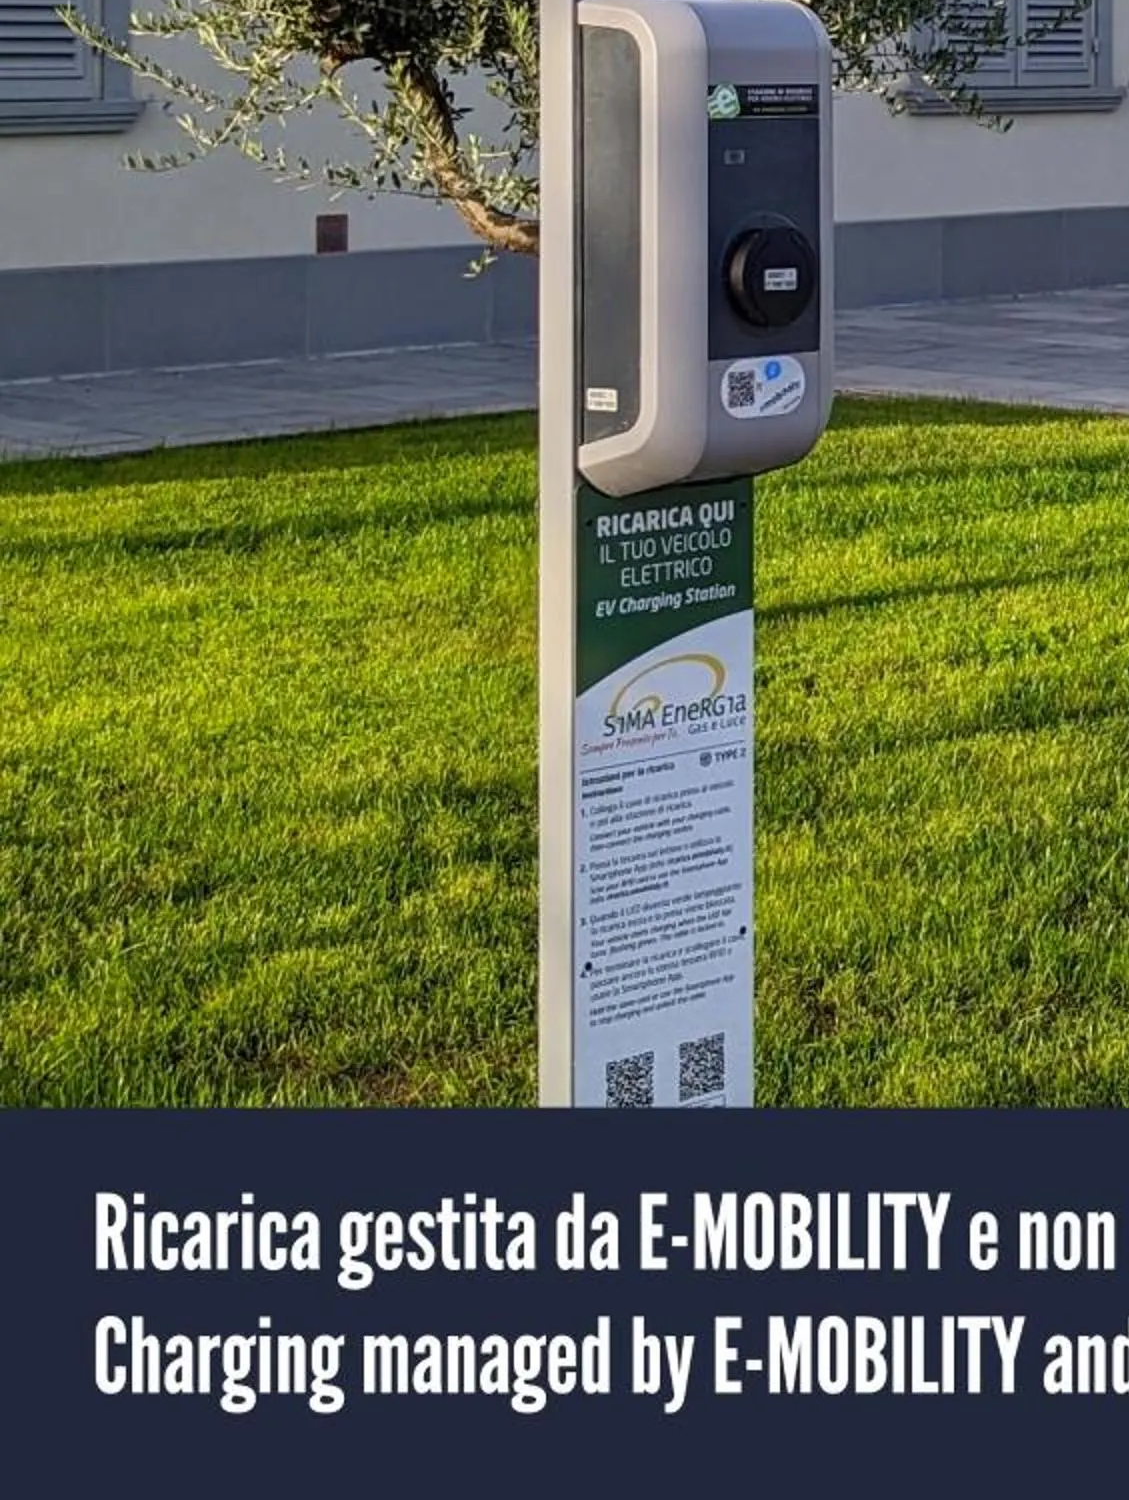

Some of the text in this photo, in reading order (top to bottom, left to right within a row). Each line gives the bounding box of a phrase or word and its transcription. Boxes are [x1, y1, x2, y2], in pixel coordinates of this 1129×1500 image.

[597, 500, 735, 538] RICARICA QUI
[599, 527, 732, 564] IL TUO VEICOLO
[621, 556, 713, 588] ELETTRICO
[595, 583, 736, 618] EV Charging Station
[713, 749, 738, 762] TYPE
